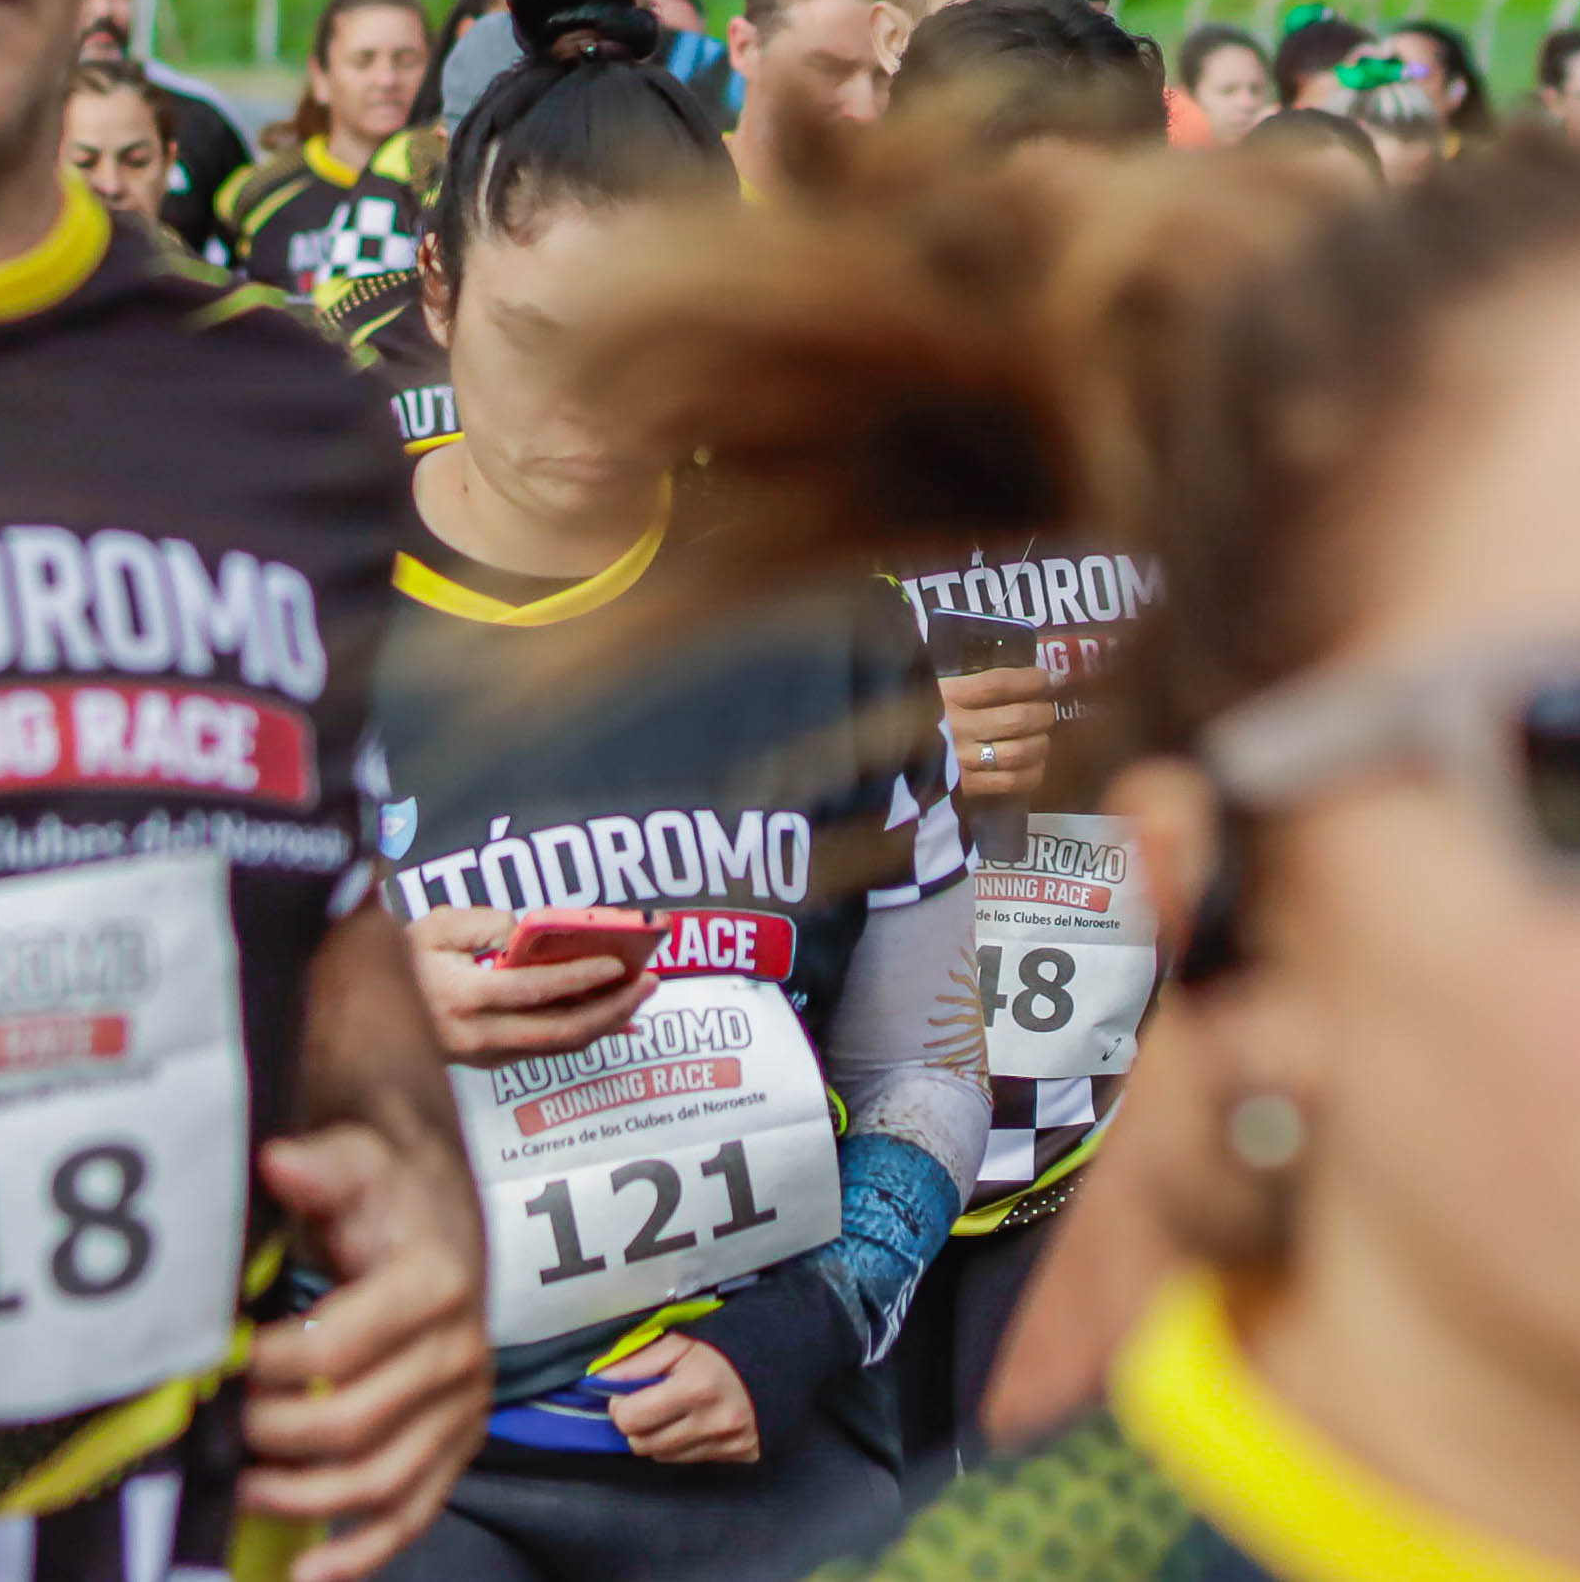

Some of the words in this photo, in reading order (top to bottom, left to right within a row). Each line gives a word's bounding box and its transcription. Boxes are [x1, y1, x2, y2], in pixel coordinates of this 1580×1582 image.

[71, 686, 261, 793] RACE
[994, 910, 1011, 923] los
[1014, 911, 1051, 926] Clubes
[1054, 915, 1072, 927] del
[1074, 917, 1121, 930] Noroeste
[1044, 882, 1092, 908] RACE
[501, 1147, 518, 1162] La
[521, 1134, 575, 1158] Carrera
[578, 1128, 598, 1144] de
[600, 1123, 622, 1139] los
[625, 1110, 674, 1133] Clubes
[677, 1103, 700, 1121] del
[703, 1090, 768, 1115] Noroeste
[539, 1072, 646, 1128] RUNNING
[652, 1062, 716, 1096] RACE
[525, 1138, 778, 1286] 121
